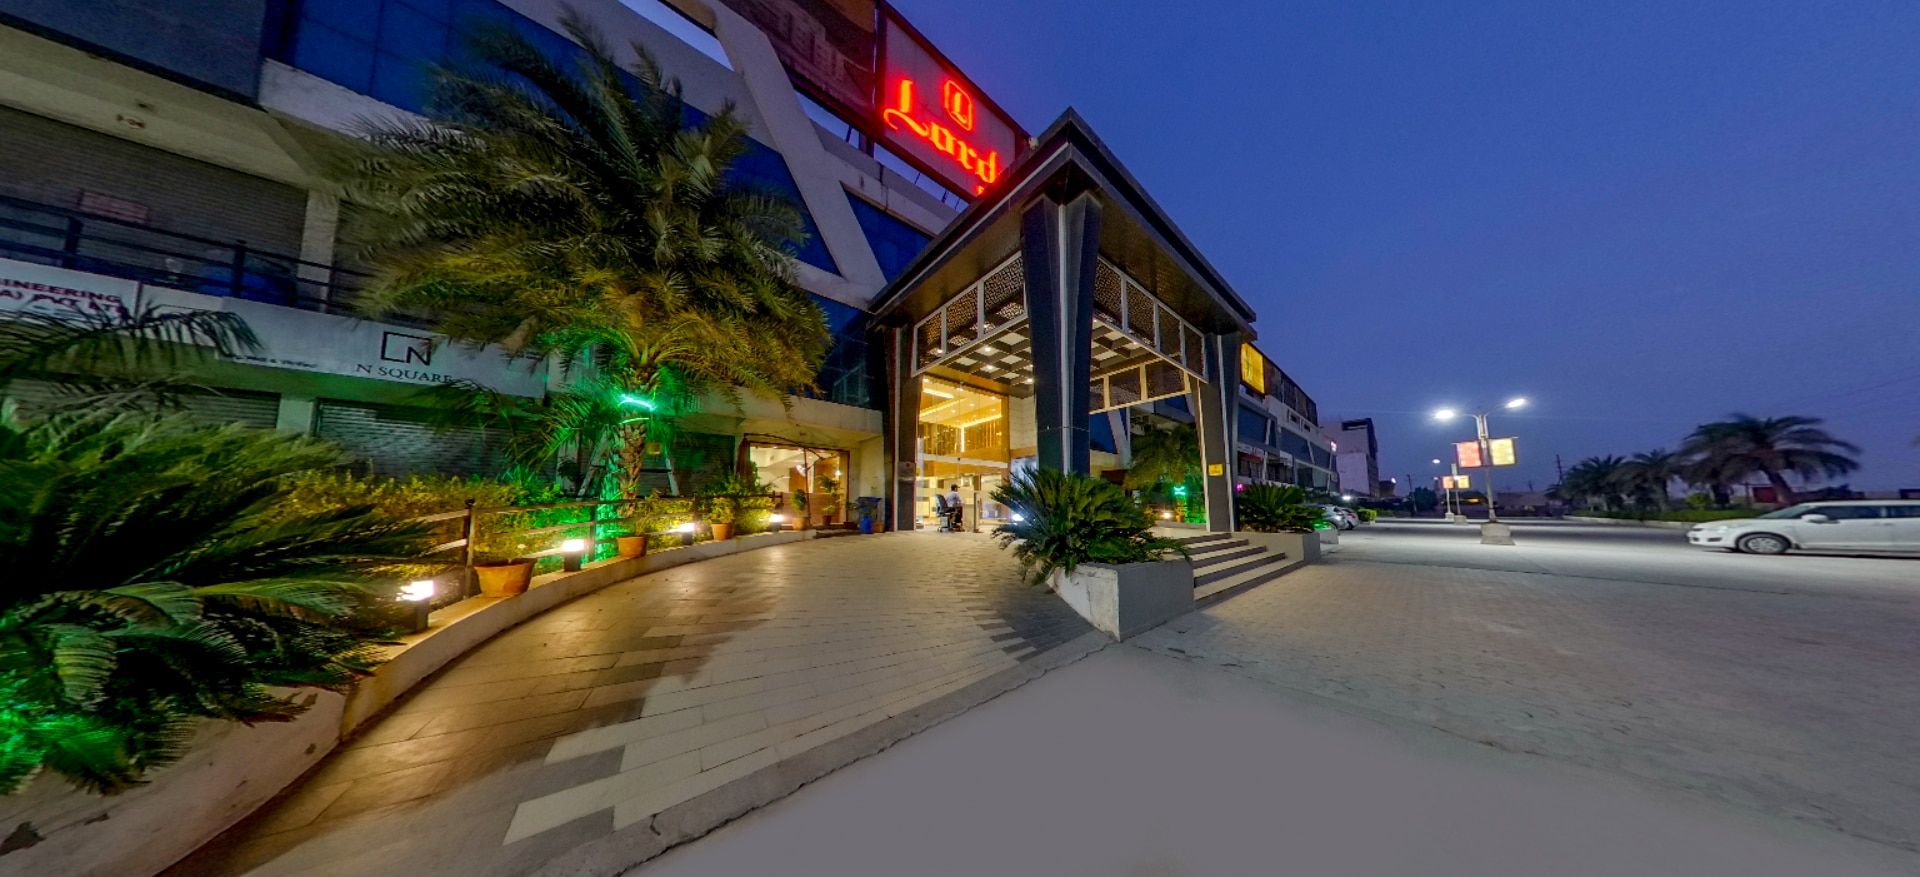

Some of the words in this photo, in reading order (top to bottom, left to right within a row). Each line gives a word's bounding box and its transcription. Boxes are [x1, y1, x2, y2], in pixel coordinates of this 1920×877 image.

[883, 79, 998, 184] Lord
[356, 363, 373, 374] N
[378, 365, 454, 384] SQUARE
